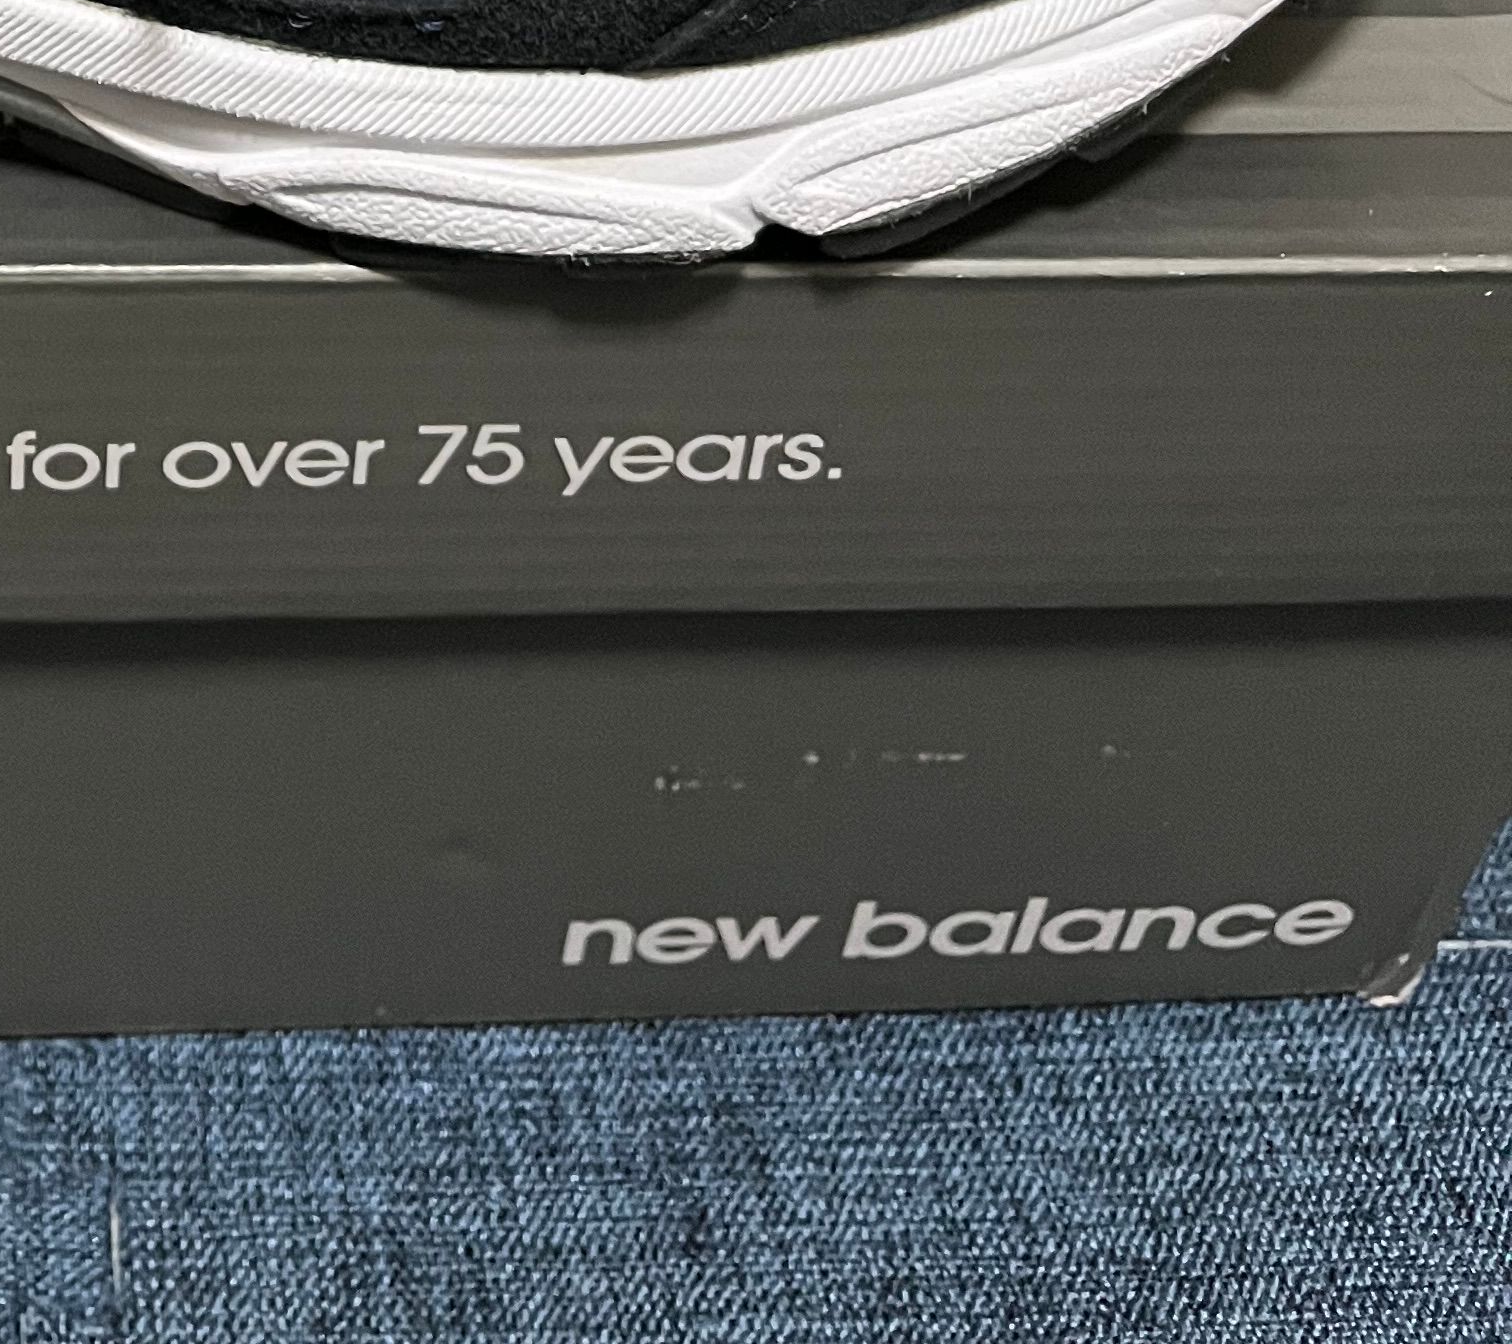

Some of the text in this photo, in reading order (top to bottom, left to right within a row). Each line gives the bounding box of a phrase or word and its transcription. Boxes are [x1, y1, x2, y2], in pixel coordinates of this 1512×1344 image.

[5, 429, 137, 492] for
[161, 438, 387, 490] over
[418, 422, 526, 486] 75
[553, 432, 843, 498] years.
[561, 895, 1355, 966] new balance
